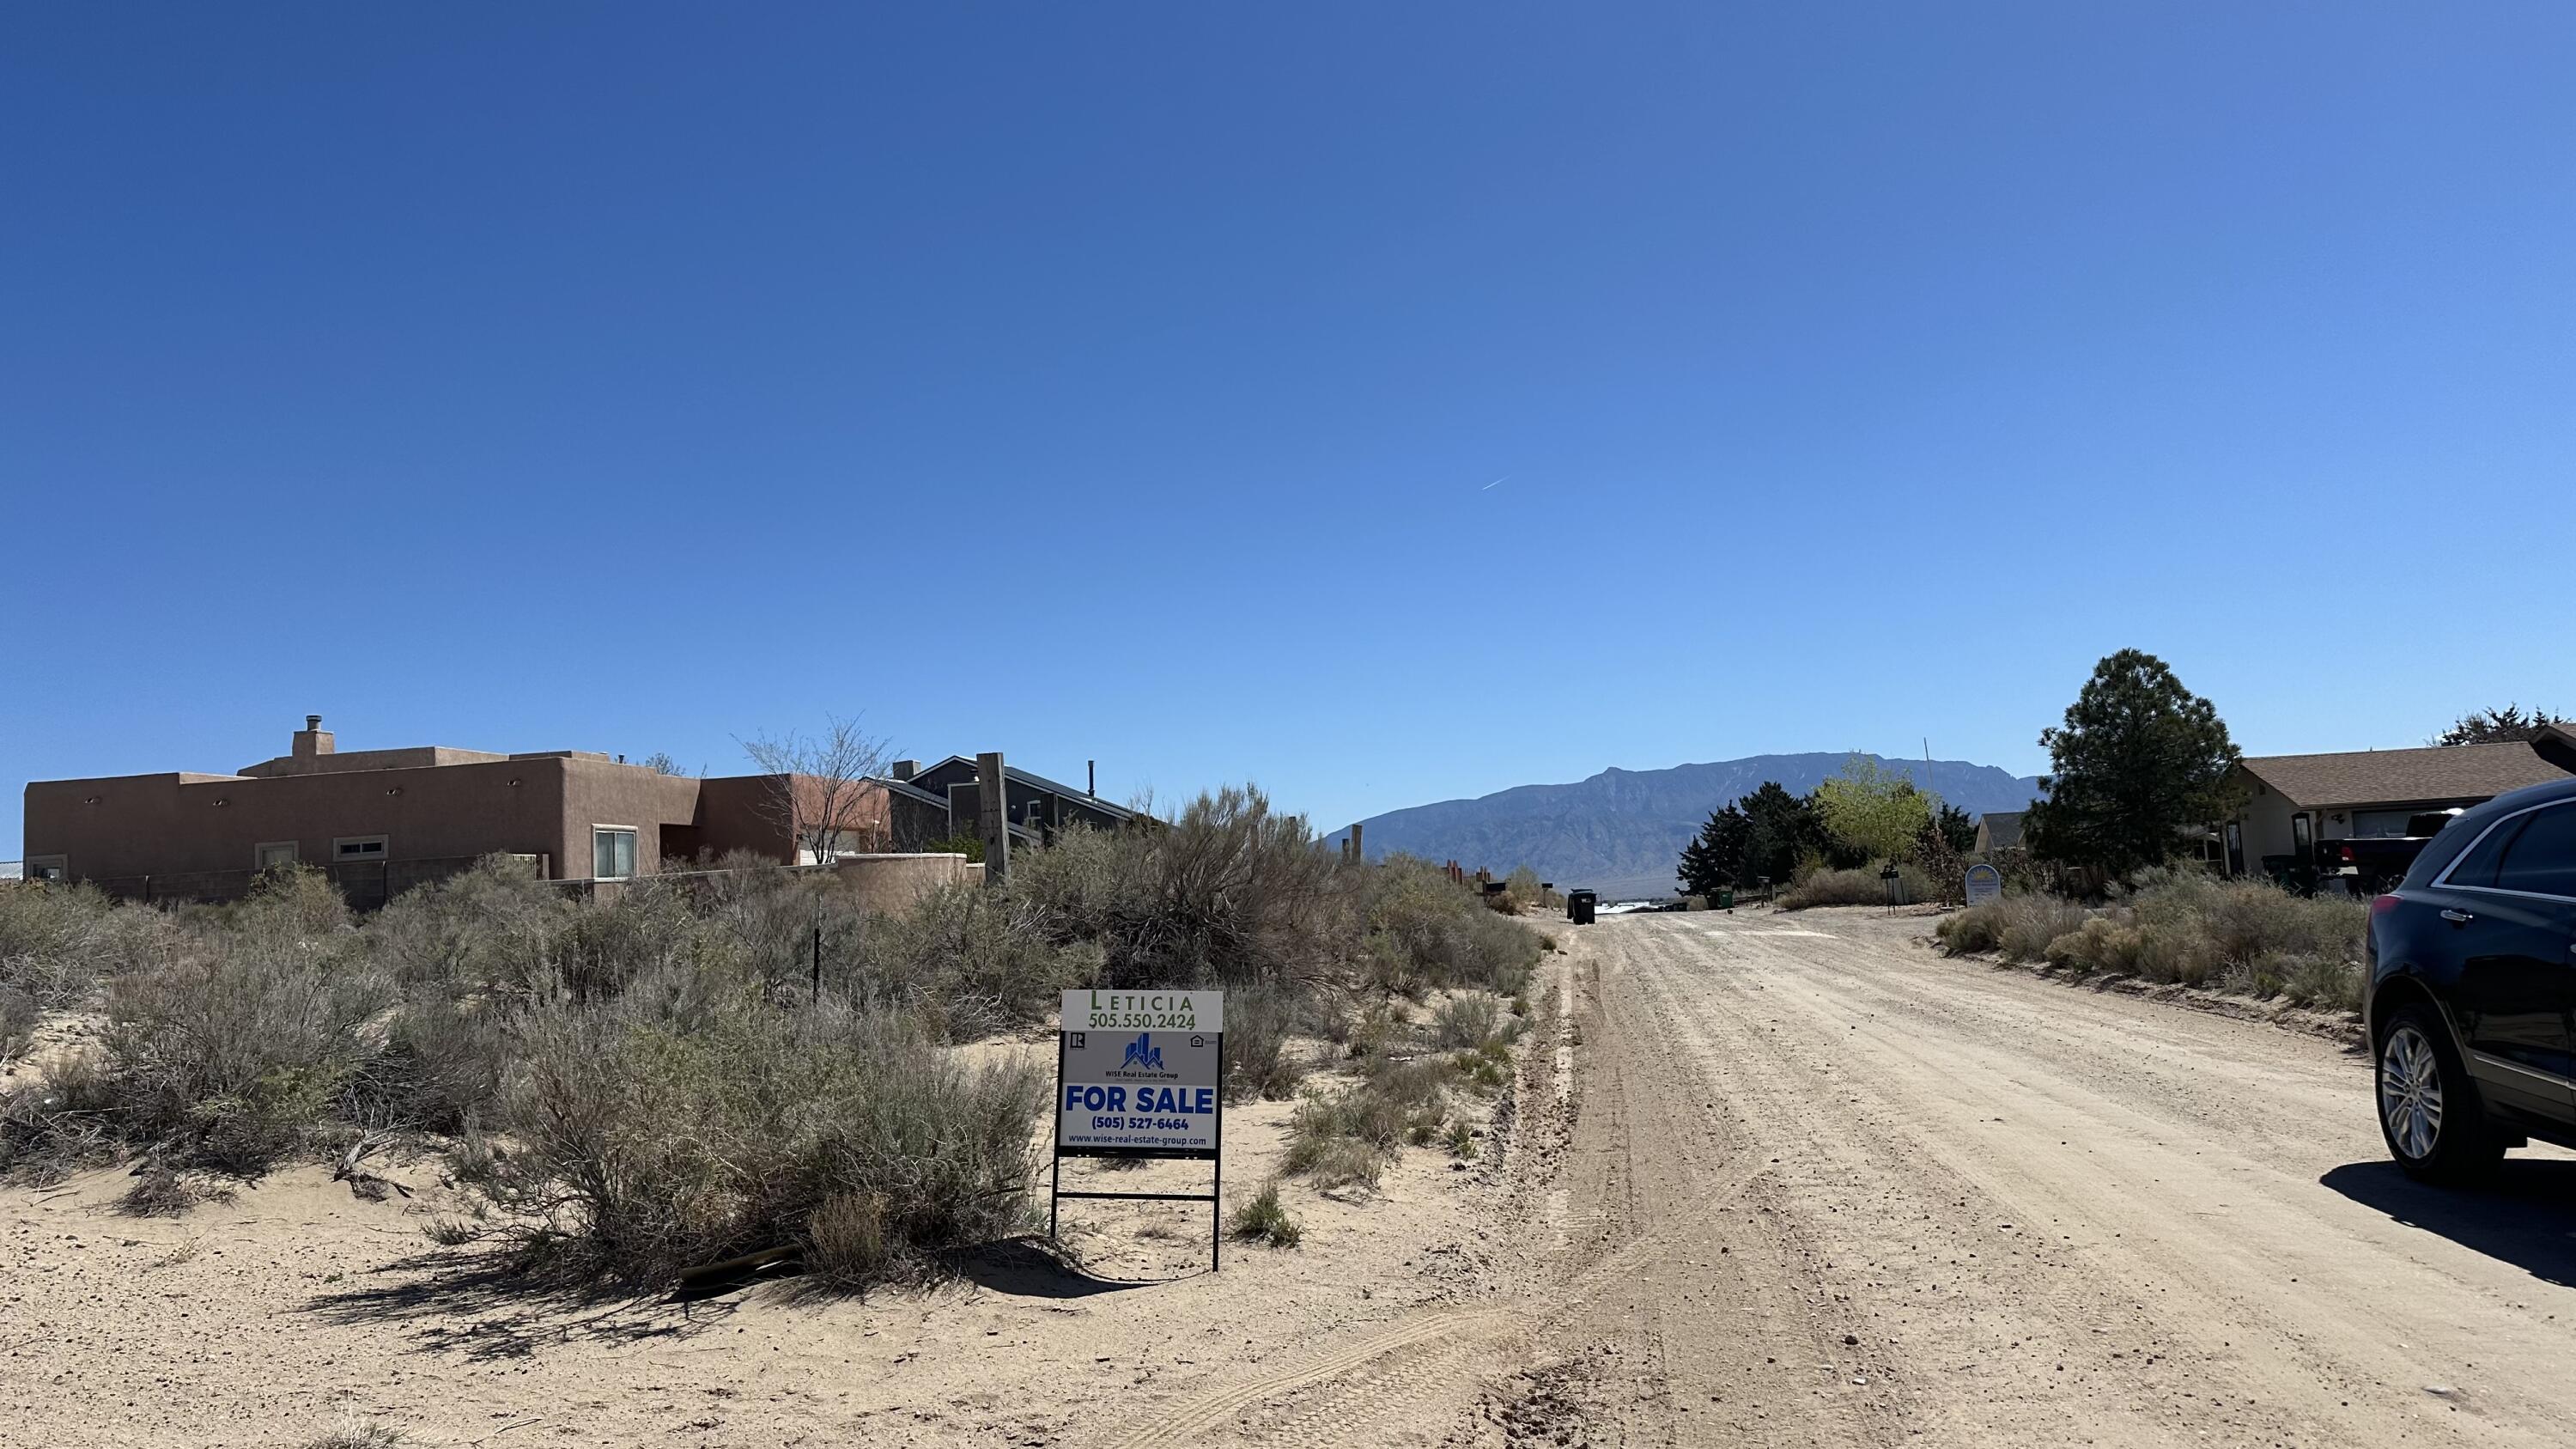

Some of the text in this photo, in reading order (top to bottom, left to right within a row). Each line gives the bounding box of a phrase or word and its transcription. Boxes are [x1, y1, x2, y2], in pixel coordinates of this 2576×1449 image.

[1091, 990, 1194, 1011] LETICIA
[1089, 1014, 1195, 1029] 505.550.2424
[1066, 1086, 1213, 1114] FOR SALE
[1092, 1117, 1188, 1130] (505) 527-6464
[1068, 1134, 1206, 1146] www.wise-real-estate-group.com
